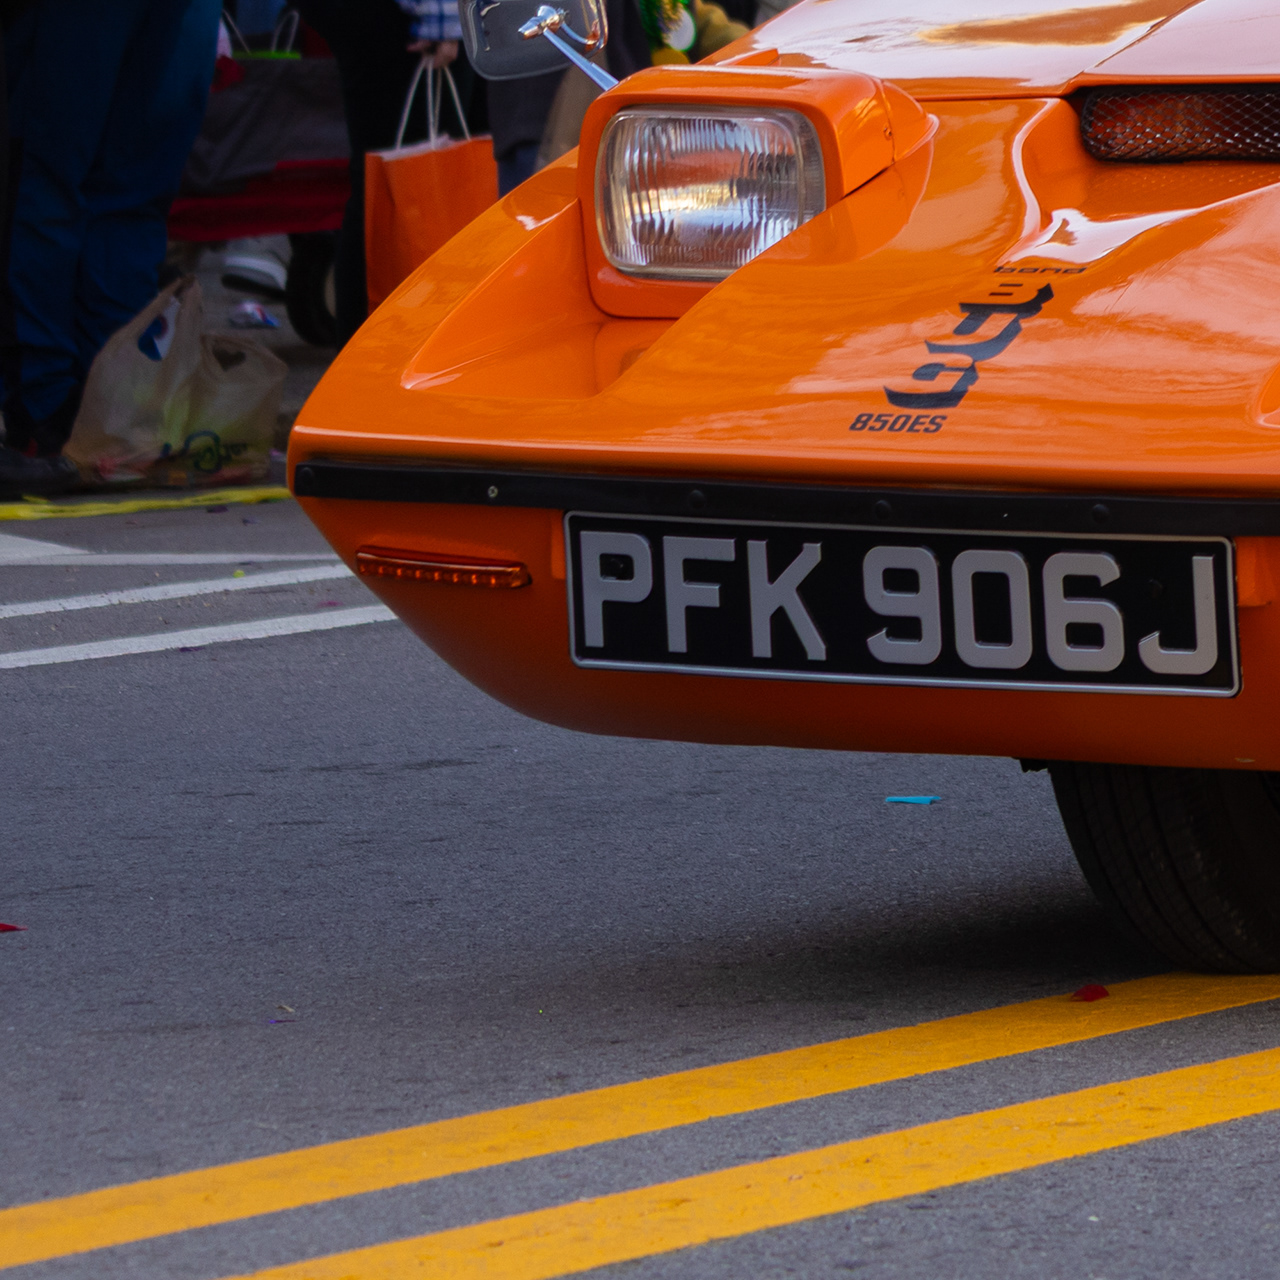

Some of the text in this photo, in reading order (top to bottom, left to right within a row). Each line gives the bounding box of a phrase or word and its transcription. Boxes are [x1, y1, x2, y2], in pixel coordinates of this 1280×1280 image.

[848, 412, 948, 435] 850ES
[579, 529, 1220, 676] PFK 906J
